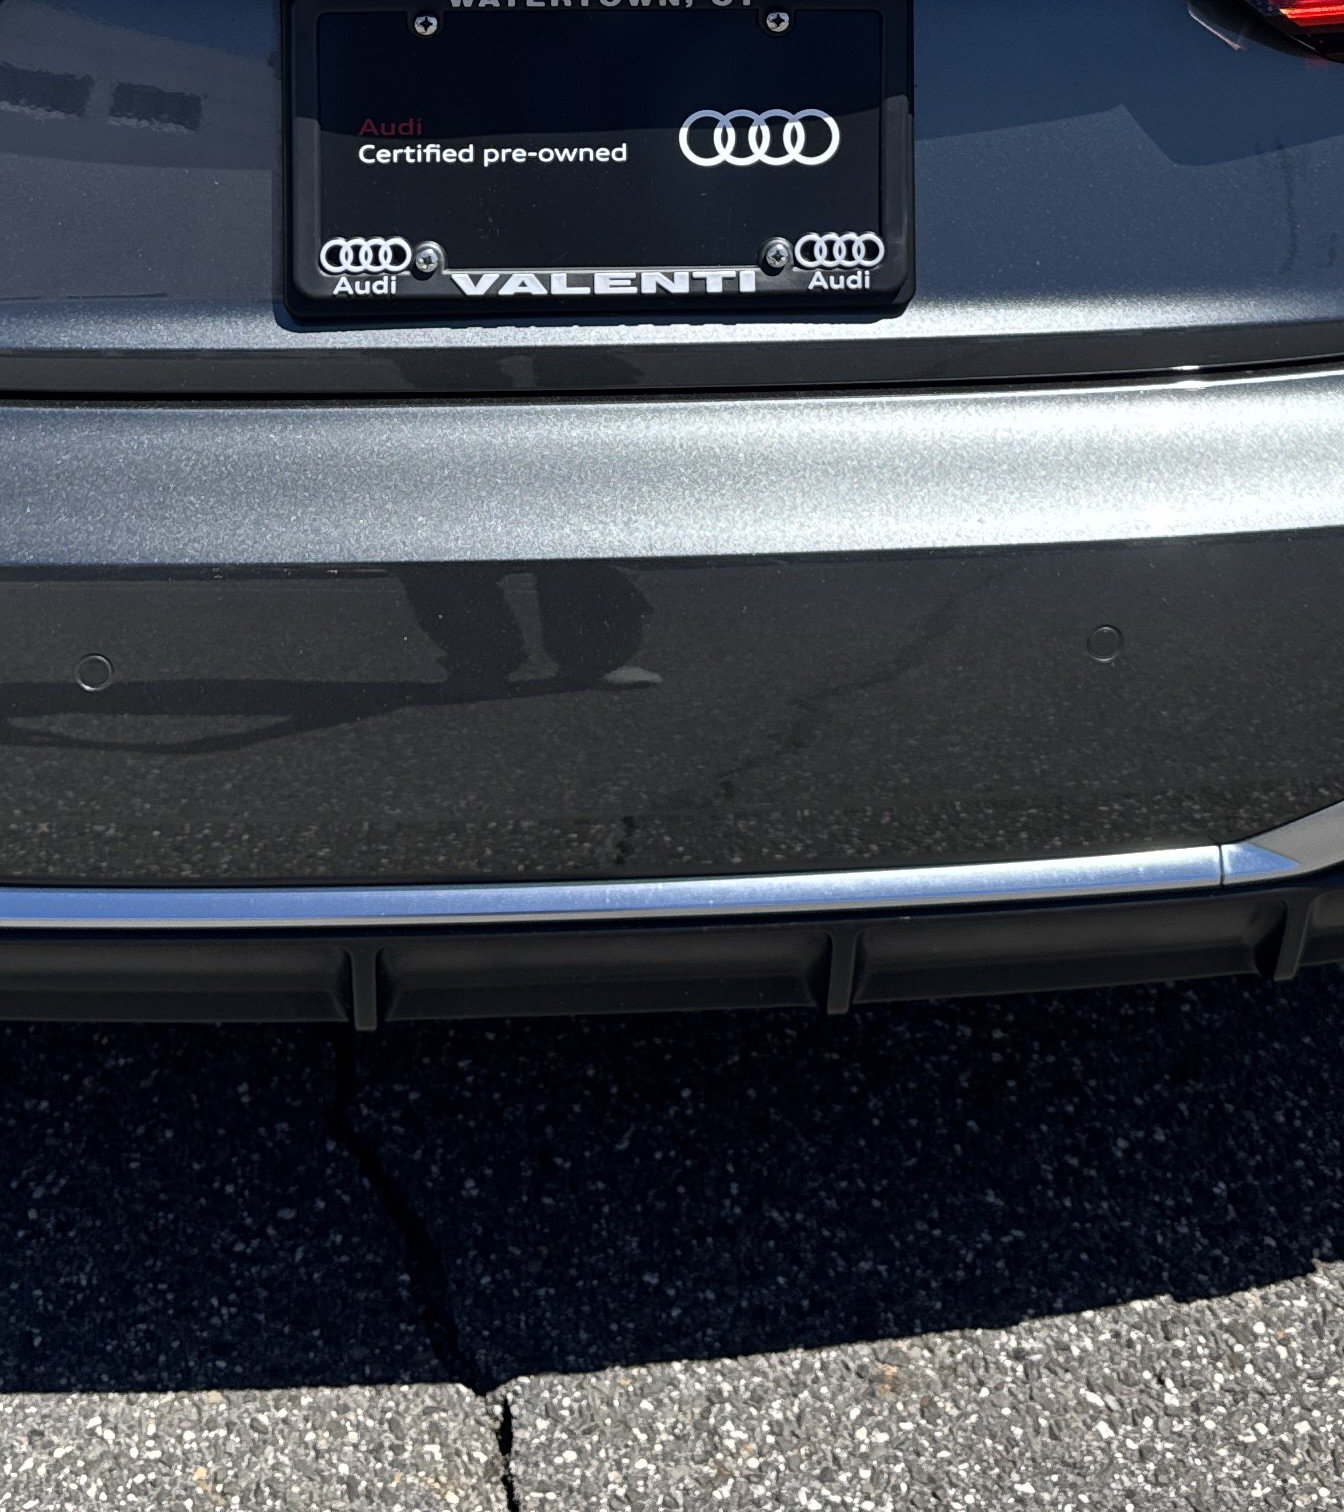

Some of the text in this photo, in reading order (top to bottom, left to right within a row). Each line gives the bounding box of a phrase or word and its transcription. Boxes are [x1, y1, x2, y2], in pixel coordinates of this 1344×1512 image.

[358, 118, 423, 136] Audi
[358, 143, 628, 168] Certified pre-owned
[332, 275, 397, 295] Audi
[451, 270, 756, 296] VALENTI
[808, 270, 871, 290] Audi
